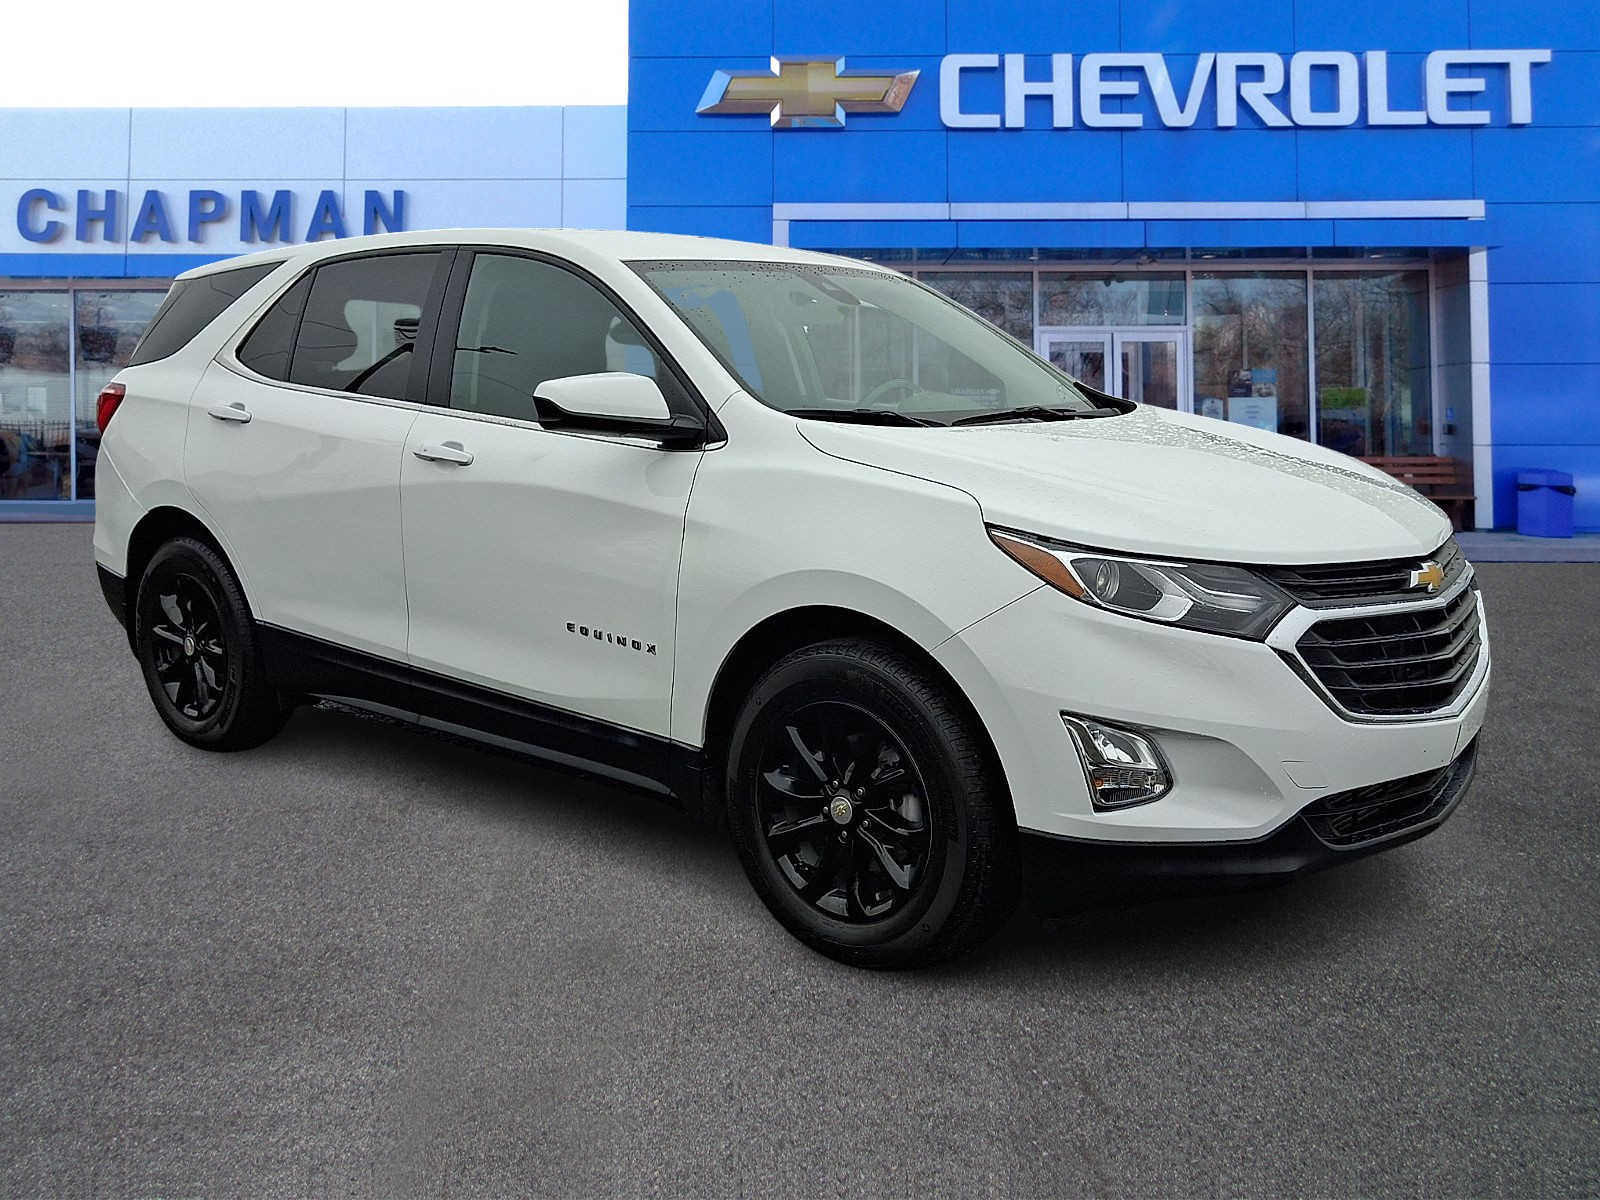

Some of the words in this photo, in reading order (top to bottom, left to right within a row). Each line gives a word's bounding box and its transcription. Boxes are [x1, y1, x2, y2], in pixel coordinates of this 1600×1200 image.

[940, 50, 1552, 129] CHEVROLET
[17, 188, 406, 243] CHAPMAN
[566, 622, 657, 655] EQUINOX
